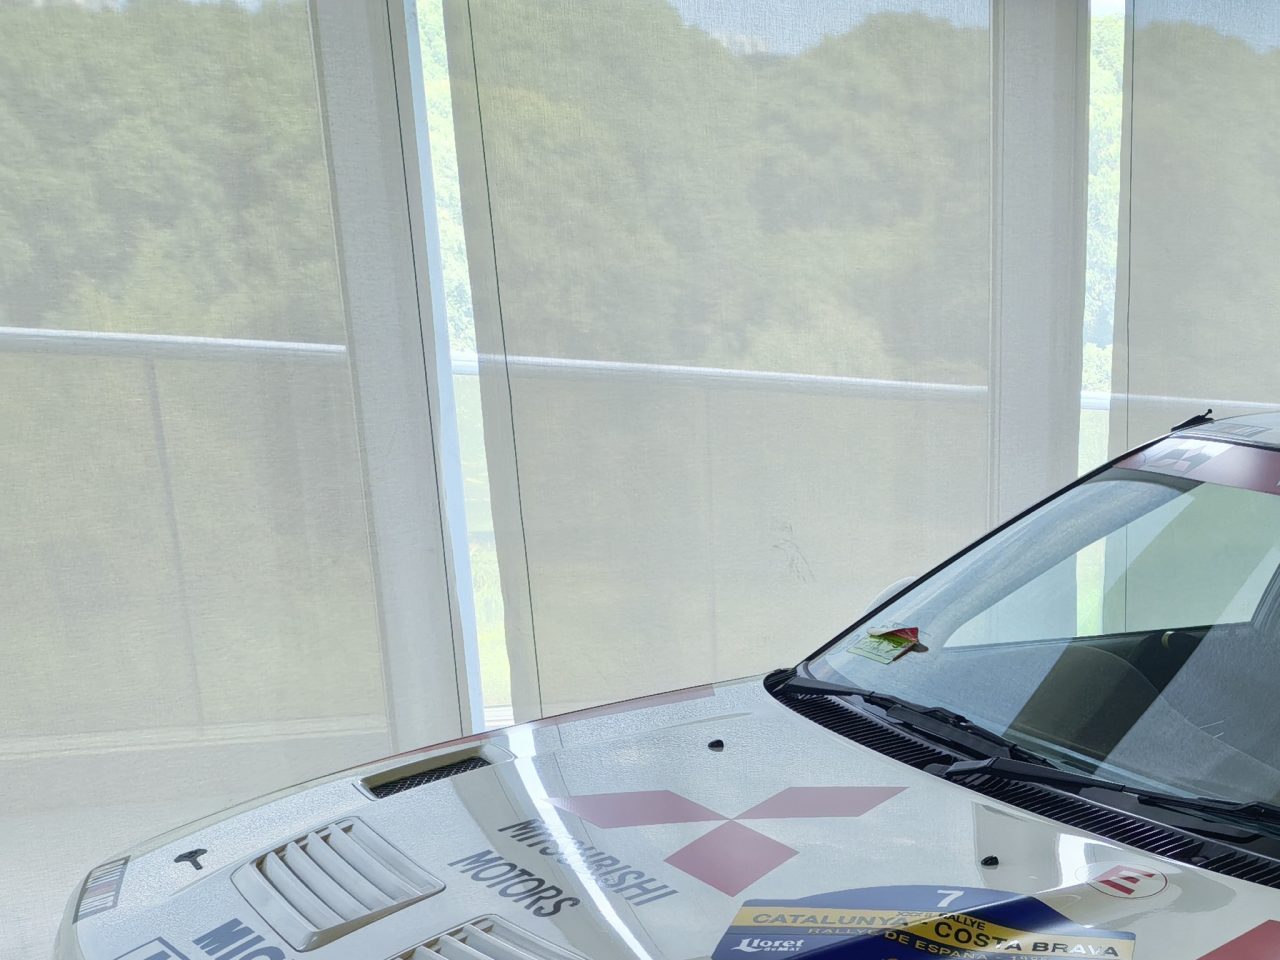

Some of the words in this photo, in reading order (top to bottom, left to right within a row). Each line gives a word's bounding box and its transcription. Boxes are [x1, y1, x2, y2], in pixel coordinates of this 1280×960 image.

[447, 849, 581, 918] MOTORS
[936, 889, 965, 908] 7
[753, 913, 908, 927] CATALUNYA
[934, 921, 1022, 952] COSTA
[1032, 942, 1119, 957] BRAVA
[884, 930, 909, 945] DE
[734, 937, 805, 953] Lloret
